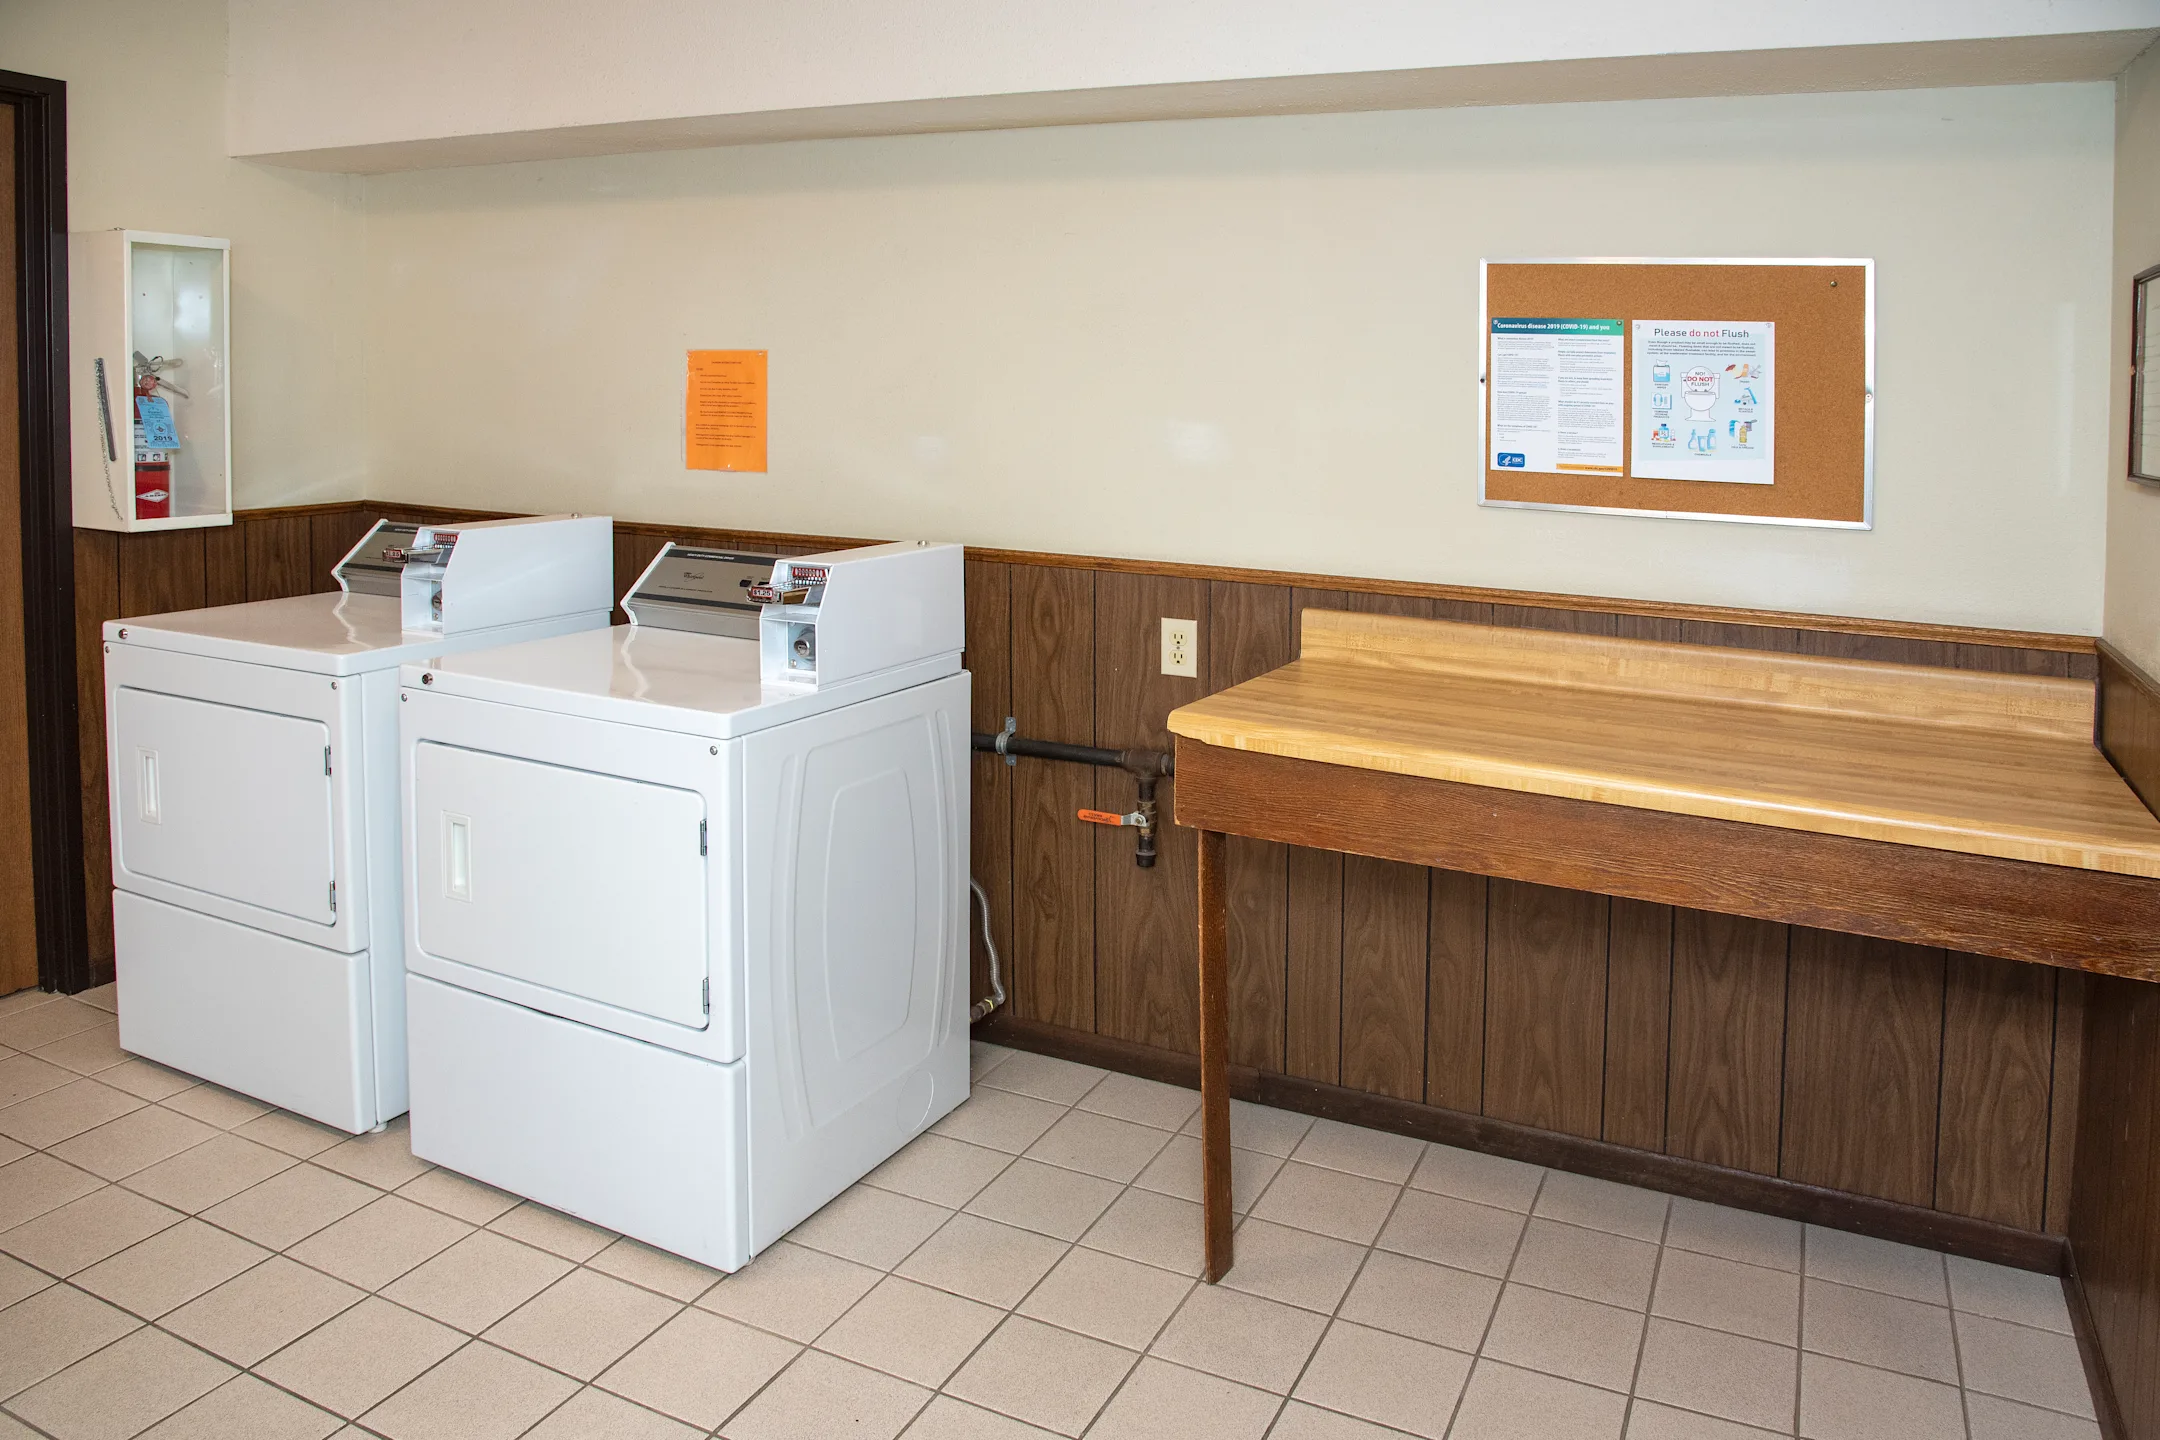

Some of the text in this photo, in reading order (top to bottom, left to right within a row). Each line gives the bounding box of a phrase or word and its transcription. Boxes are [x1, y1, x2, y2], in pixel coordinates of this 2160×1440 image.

[1527, 322, 1546, 330] disease
[1561, 323, 1588, 331] (COVID-19)
[1654, 328, 1750, 338] Please do not Flush
